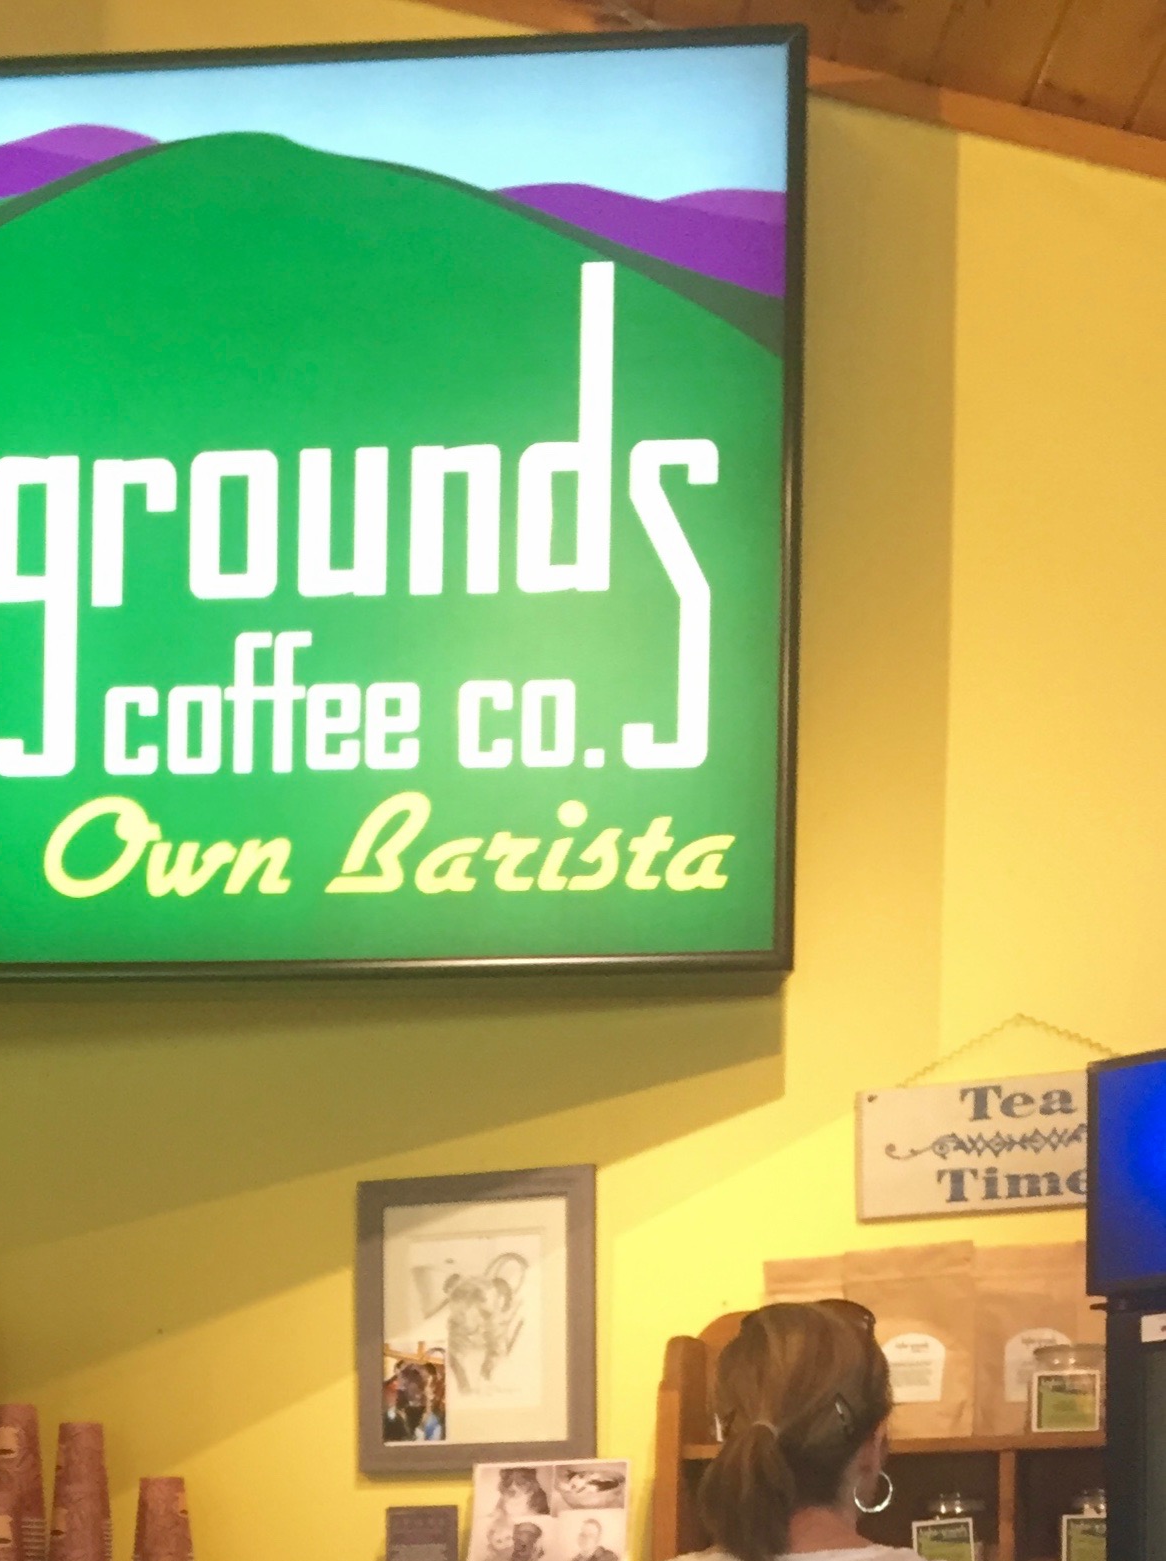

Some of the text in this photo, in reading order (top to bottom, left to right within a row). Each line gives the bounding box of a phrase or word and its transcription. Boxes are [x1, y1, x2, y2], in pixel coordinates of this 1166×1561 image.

[104, 631, 606, 775] coffee co.
[43, 796, 292, 899] Own
[324, 790, 737, 895] Barista
[959, 1084, 1078, 1122] Tea
